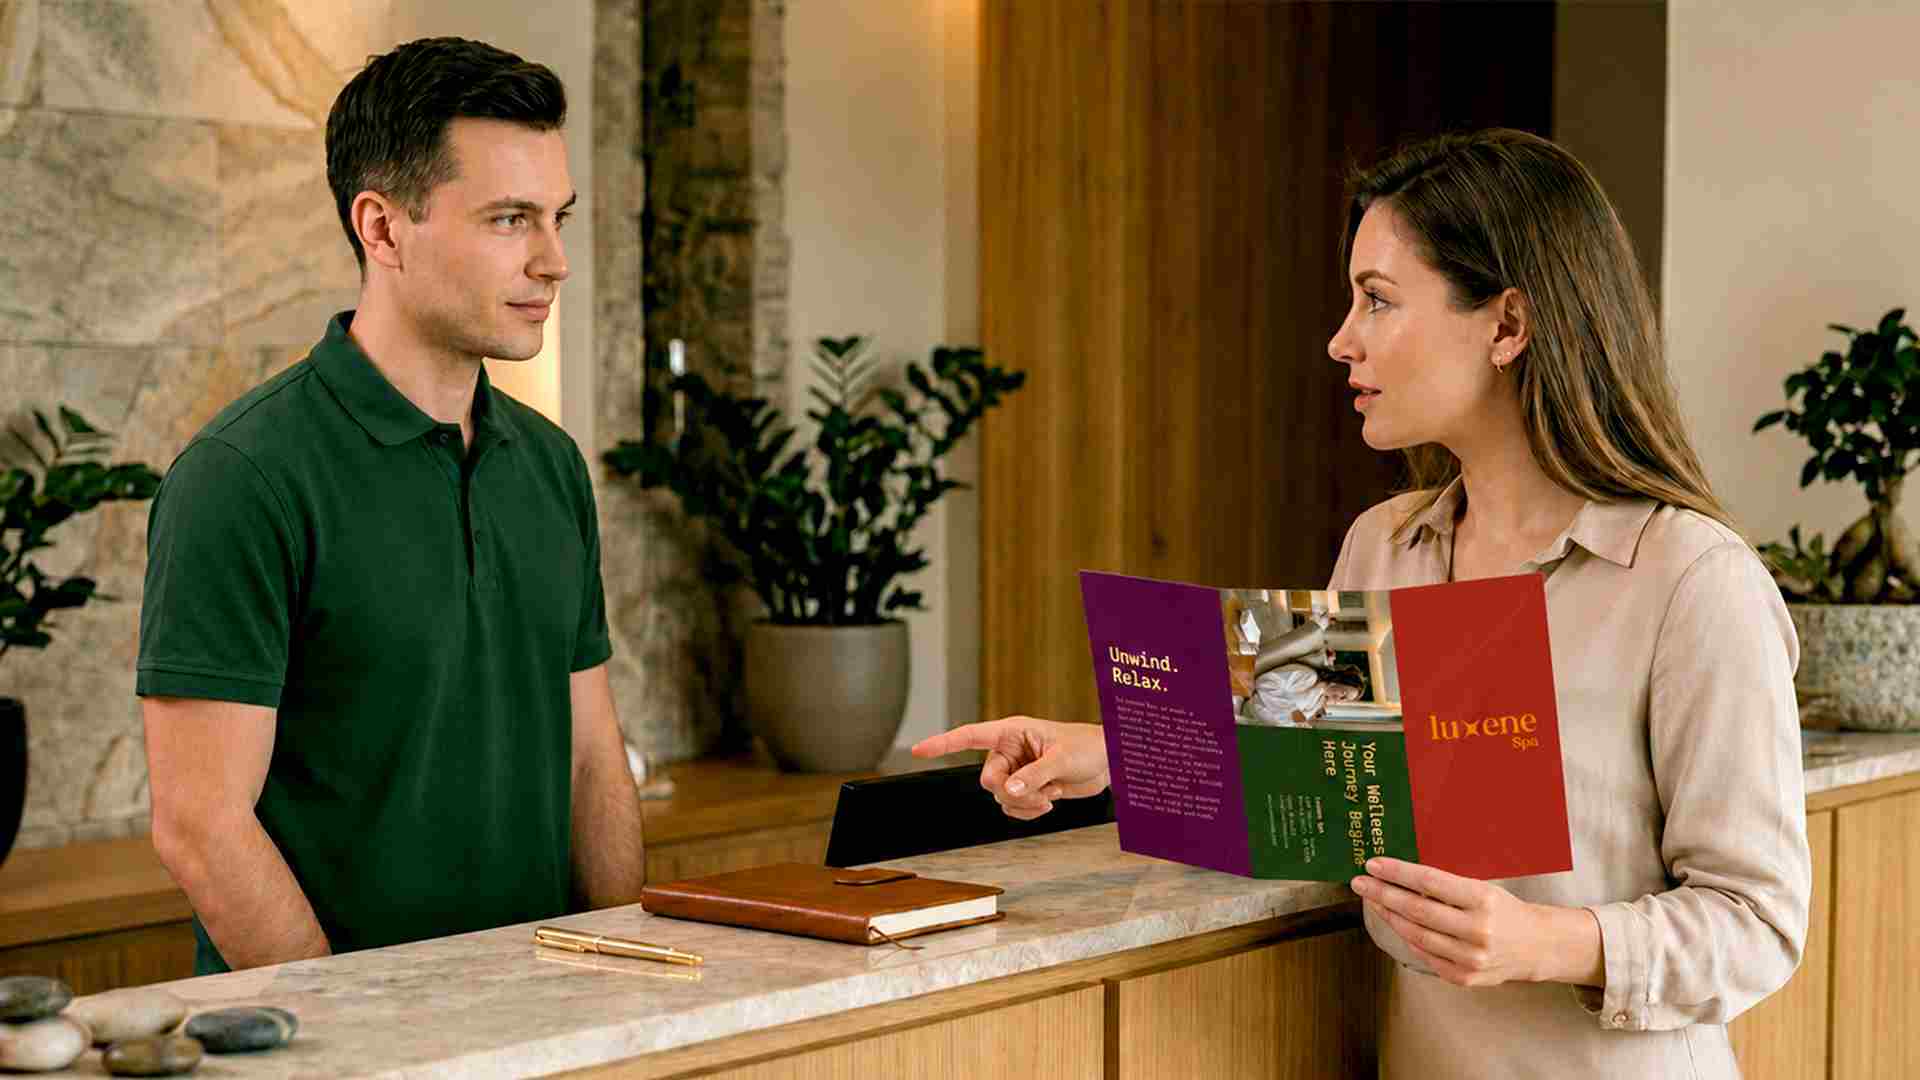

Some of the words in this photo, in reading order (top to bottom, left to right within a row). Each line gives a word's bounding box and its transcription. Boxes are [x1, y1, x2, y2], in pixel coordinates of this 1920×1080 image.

[1108, 646, 1178, 673] Unwind.
[1112, 666, 1168, 692] Relax.
[1429, 713, 1537, 741] luxene
[1322, 740, 1337, 777] Here
[1341, 740, 1359, 803] Journey
[1361, 741, 1377, 777] Your
